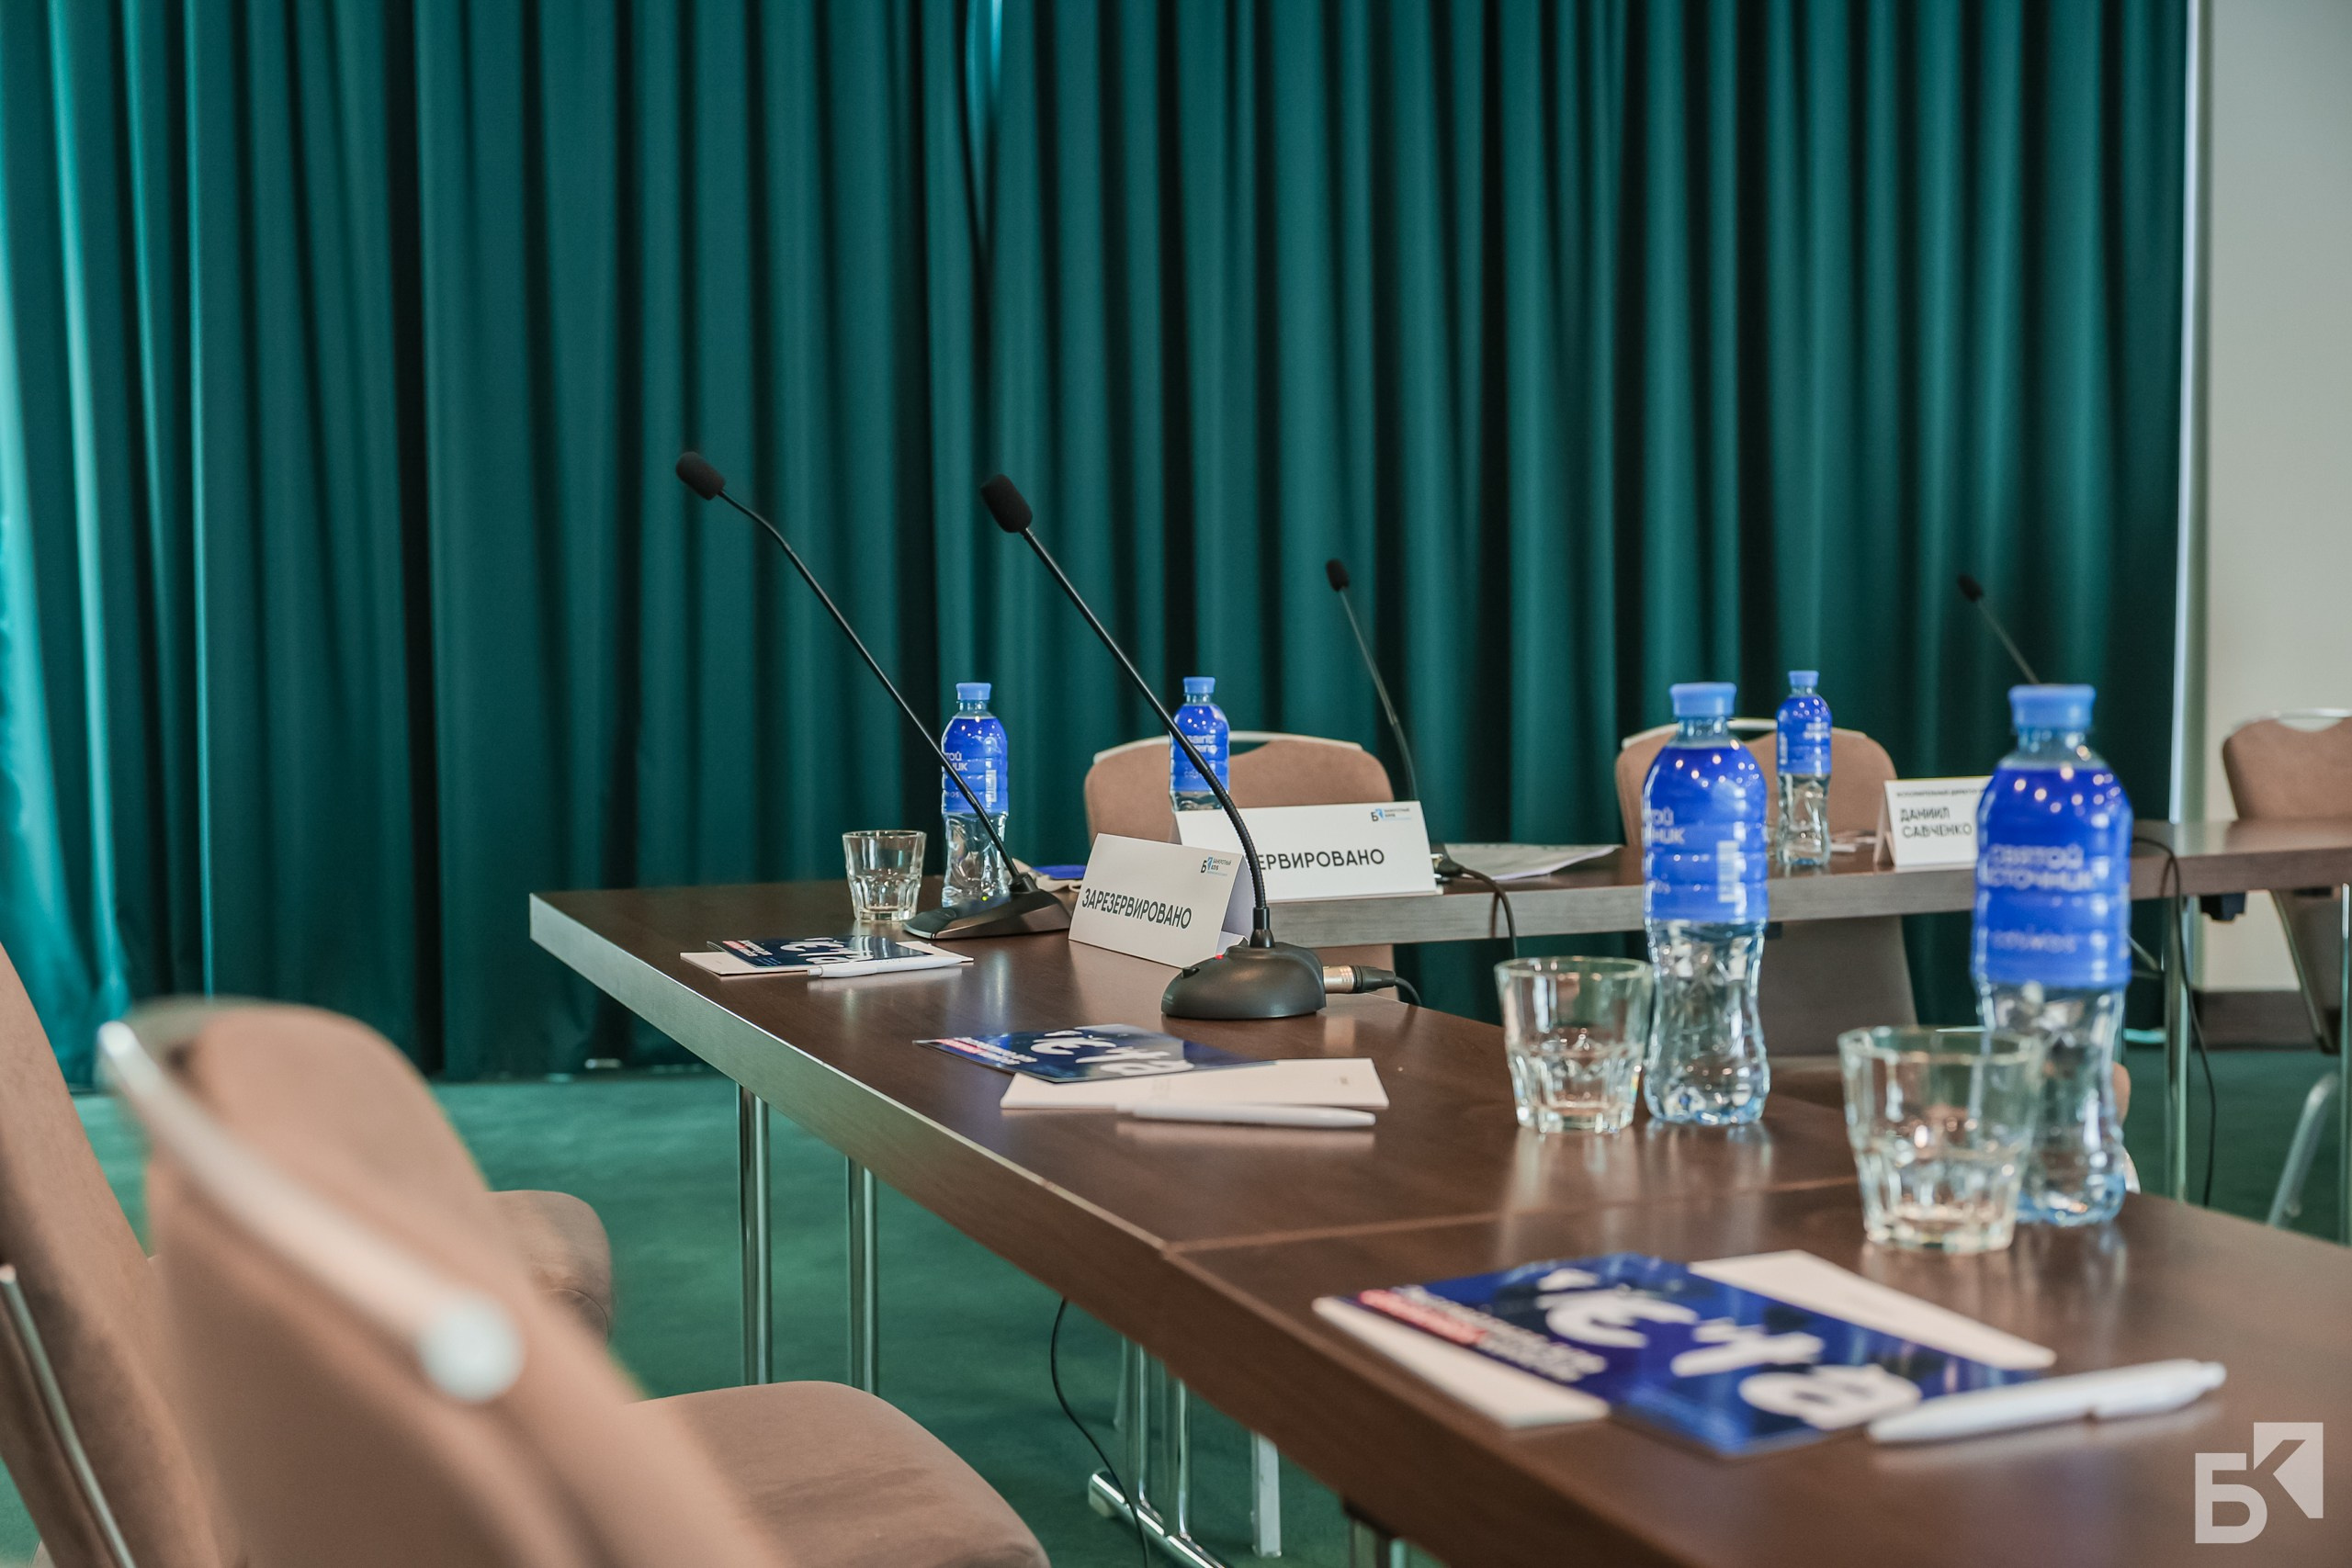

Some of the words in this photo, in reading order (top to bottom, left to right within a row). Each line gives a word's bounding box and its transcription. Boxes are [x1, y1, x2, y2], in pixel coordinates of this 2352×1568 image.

[1900, 807, 1951, 822] ДАНИИЛ
[1902, 823, 1973, 838] САВЧЕНКО
[1259, 849, 1385, 871] ЕРВИРОВАНО
[1081, 887, 1192, 929] ЗАРЕЗЕРВИРОВАНО
